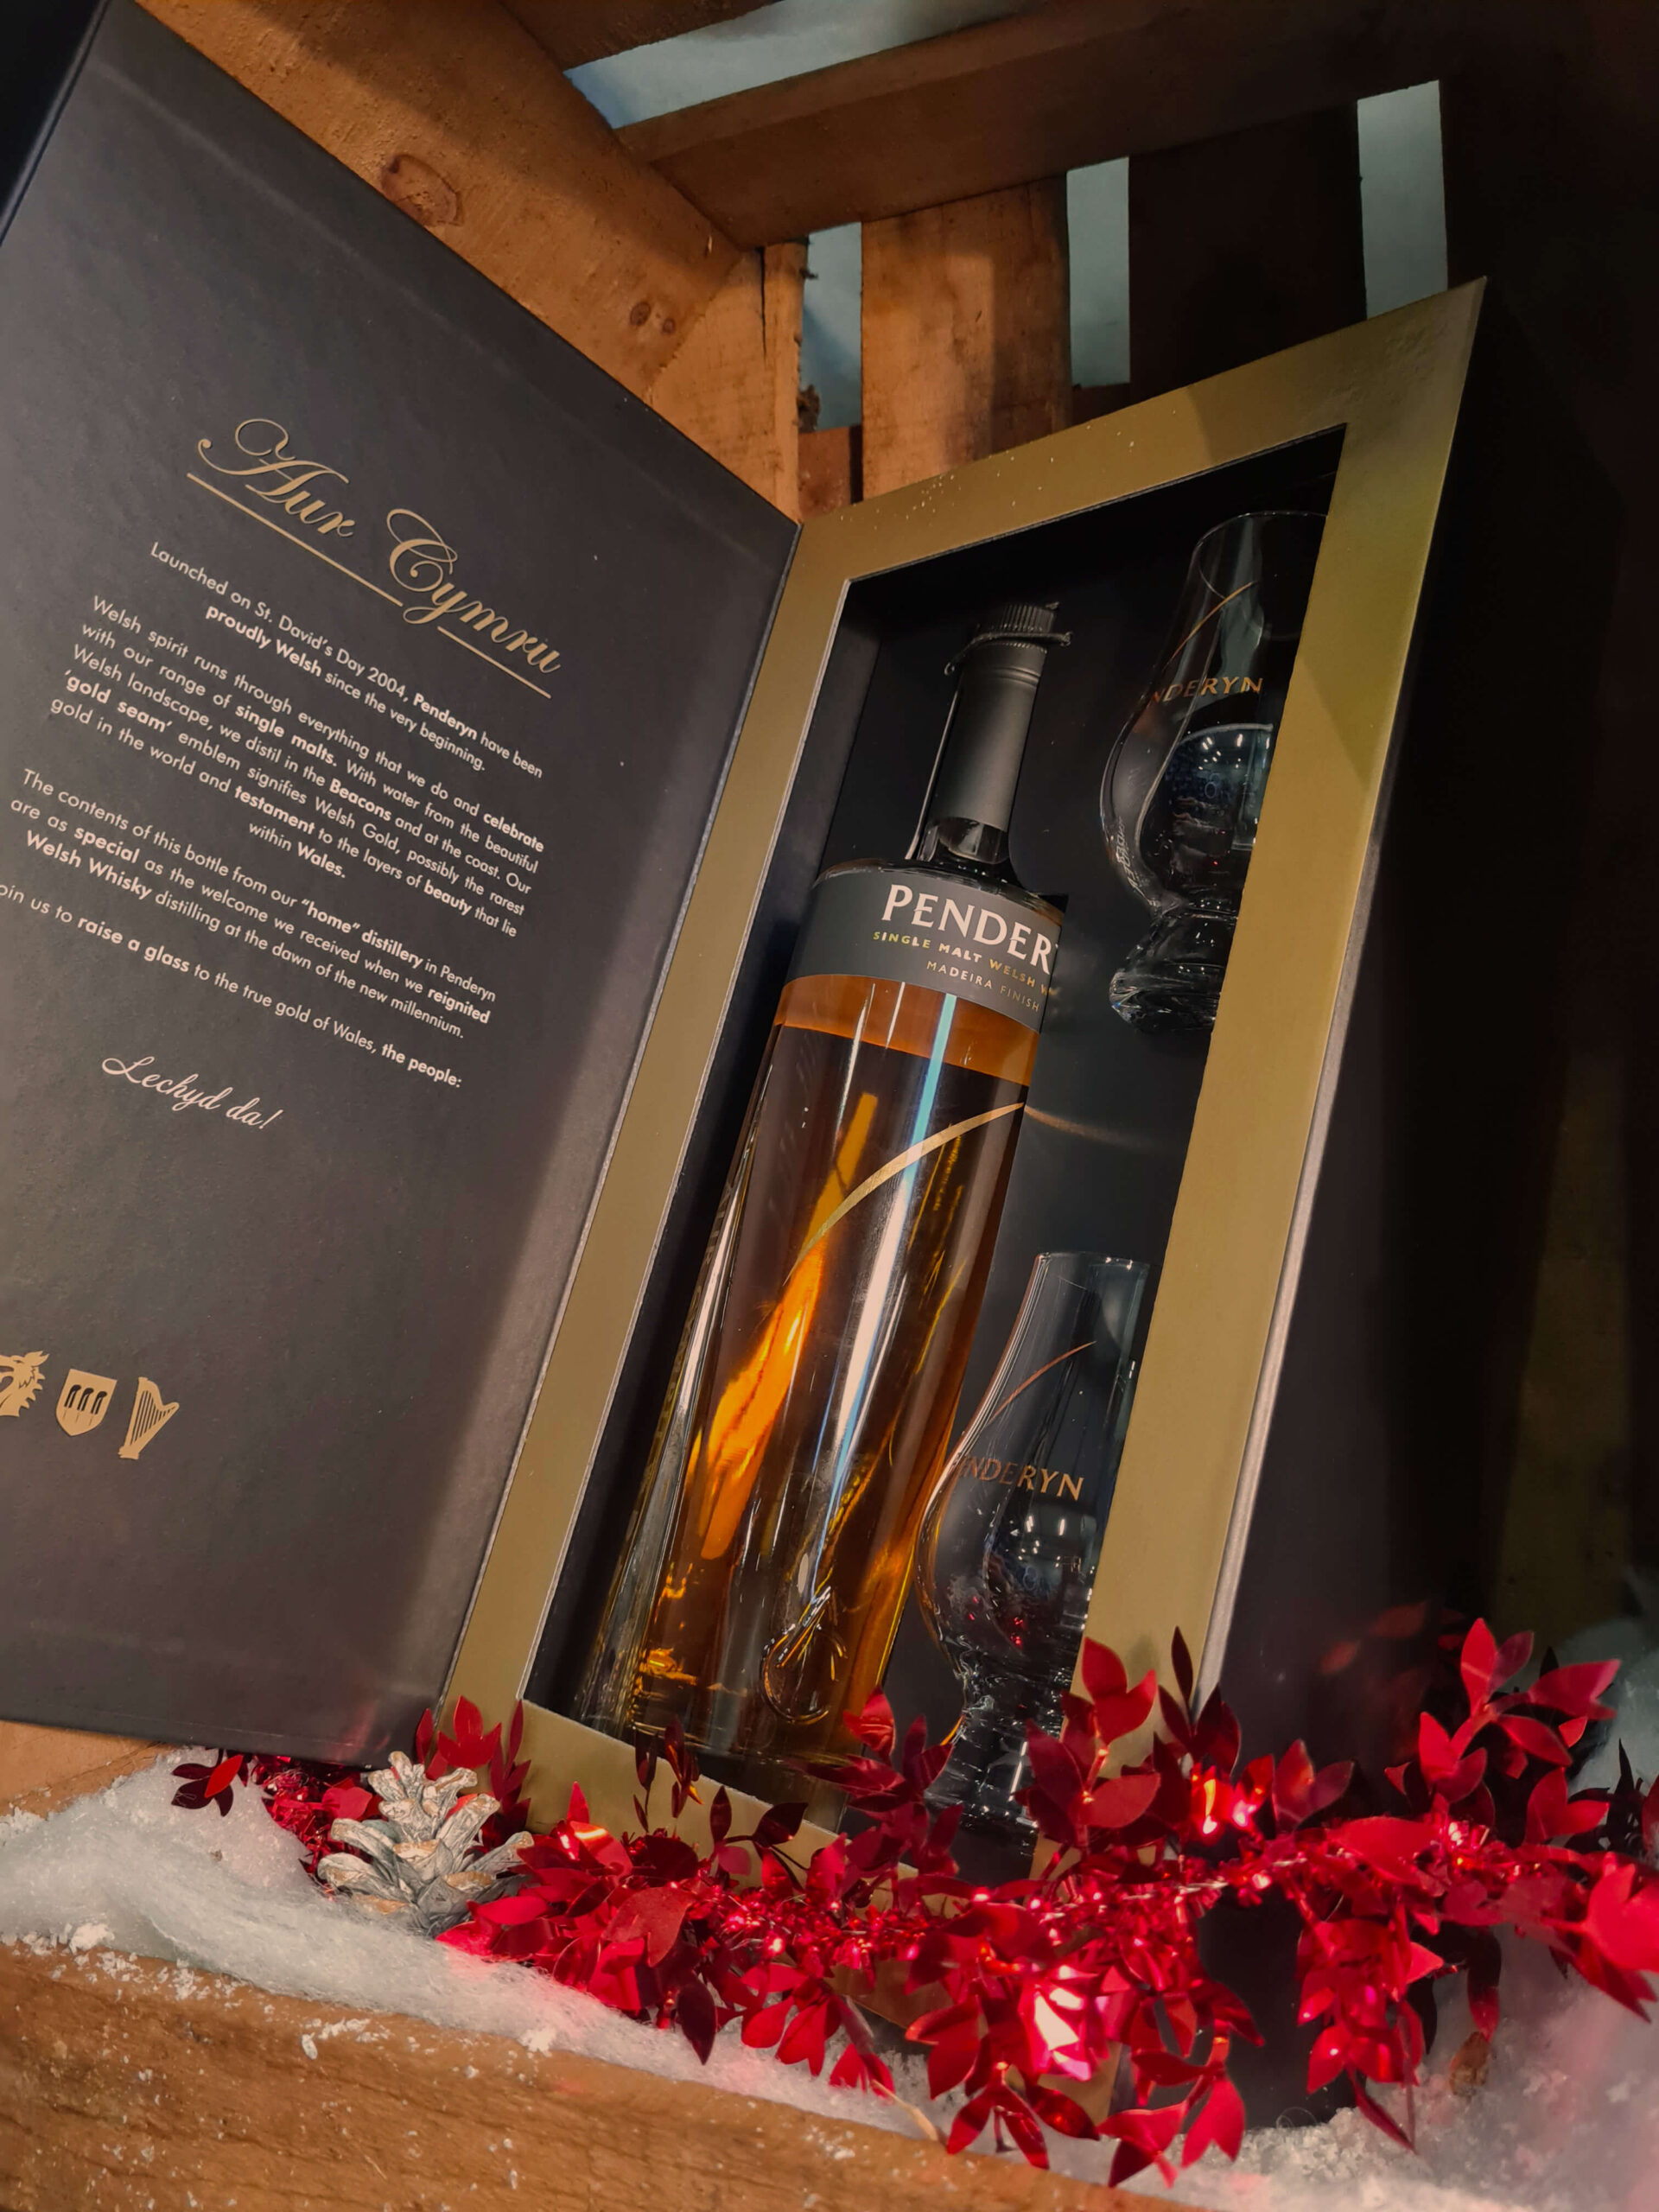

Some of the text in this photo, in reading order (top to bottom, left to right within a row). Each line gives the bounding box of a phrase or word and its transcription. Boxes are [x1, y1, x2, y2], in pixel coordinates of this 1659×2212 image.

[198, 418, 562, 673] Aur Cymru
[82, 624, 539, 874] with our range of single malts. With water from the beautiful
[93, 594, 544, 853] Welsh spirit runs through everything that we do and celebrate
[149, 541, 229, 595] Launched
[230, 592, 251, 610] on
[254, 601, 273, 623] St.
[335, 647, 365, 677] Day
[366, 666, 409, 702] 2004,
[412, 692, 478, 741] Penderyn
[480, 730, 511, 760] have
[512, 750, 543, 779] been
[205, 605, 486, 772] proudly Welsh since the very beginning.
[50, 698, 518, 938] gold in the world and testament to the layers of beauty that lie
[73, 643, 532, 894] Welsh landscape, we distil in the Beacons and at the coast. Our
[177, 732, 241, 771] emblem
[246, 767, 308, 804] signifies
[315, 796, 356, 830] Welsh
[362, 823, 401, 855] Gold,
[406, 849, 461, 885] possibly
[464, 875, 485, 896] the
[489, 892, 525, 916] rarest
[249, 823, 346, 879] within Wales.
[0, 884, 462, 1089] oin us to raise a glass to the true gold of Wales, the people:
[10, 799, 492, 1024] are as special as the welcome we received when we reignited
[23, 768, 54, 796] The
[57, 791, 130, 830] contents
[131, 824, 153, 840] of
[153, 831, 181, 855] this
[184, 843, 229, 877] bottle
[232, 866, 268, 895] from
[270, 889, 298, 907] our
[361, 929, 424, 969] distillery
[424, 958, 438, 975] in
[439, 964, 496, 1002] Penderyn
[27, 829, 464, 1039] Welsh Whisky distilling at the dawn of the new millennium.
[873, 931, 1036, 987] SINGLE MALT WELSH
[881, 884, 1058, 975] PENDER
[926, 960, 993, 989] MADEIRA
[1000, 985, 1040, 1013] FINISH
[101, 1056, 284, 1130] Lechyd da!
